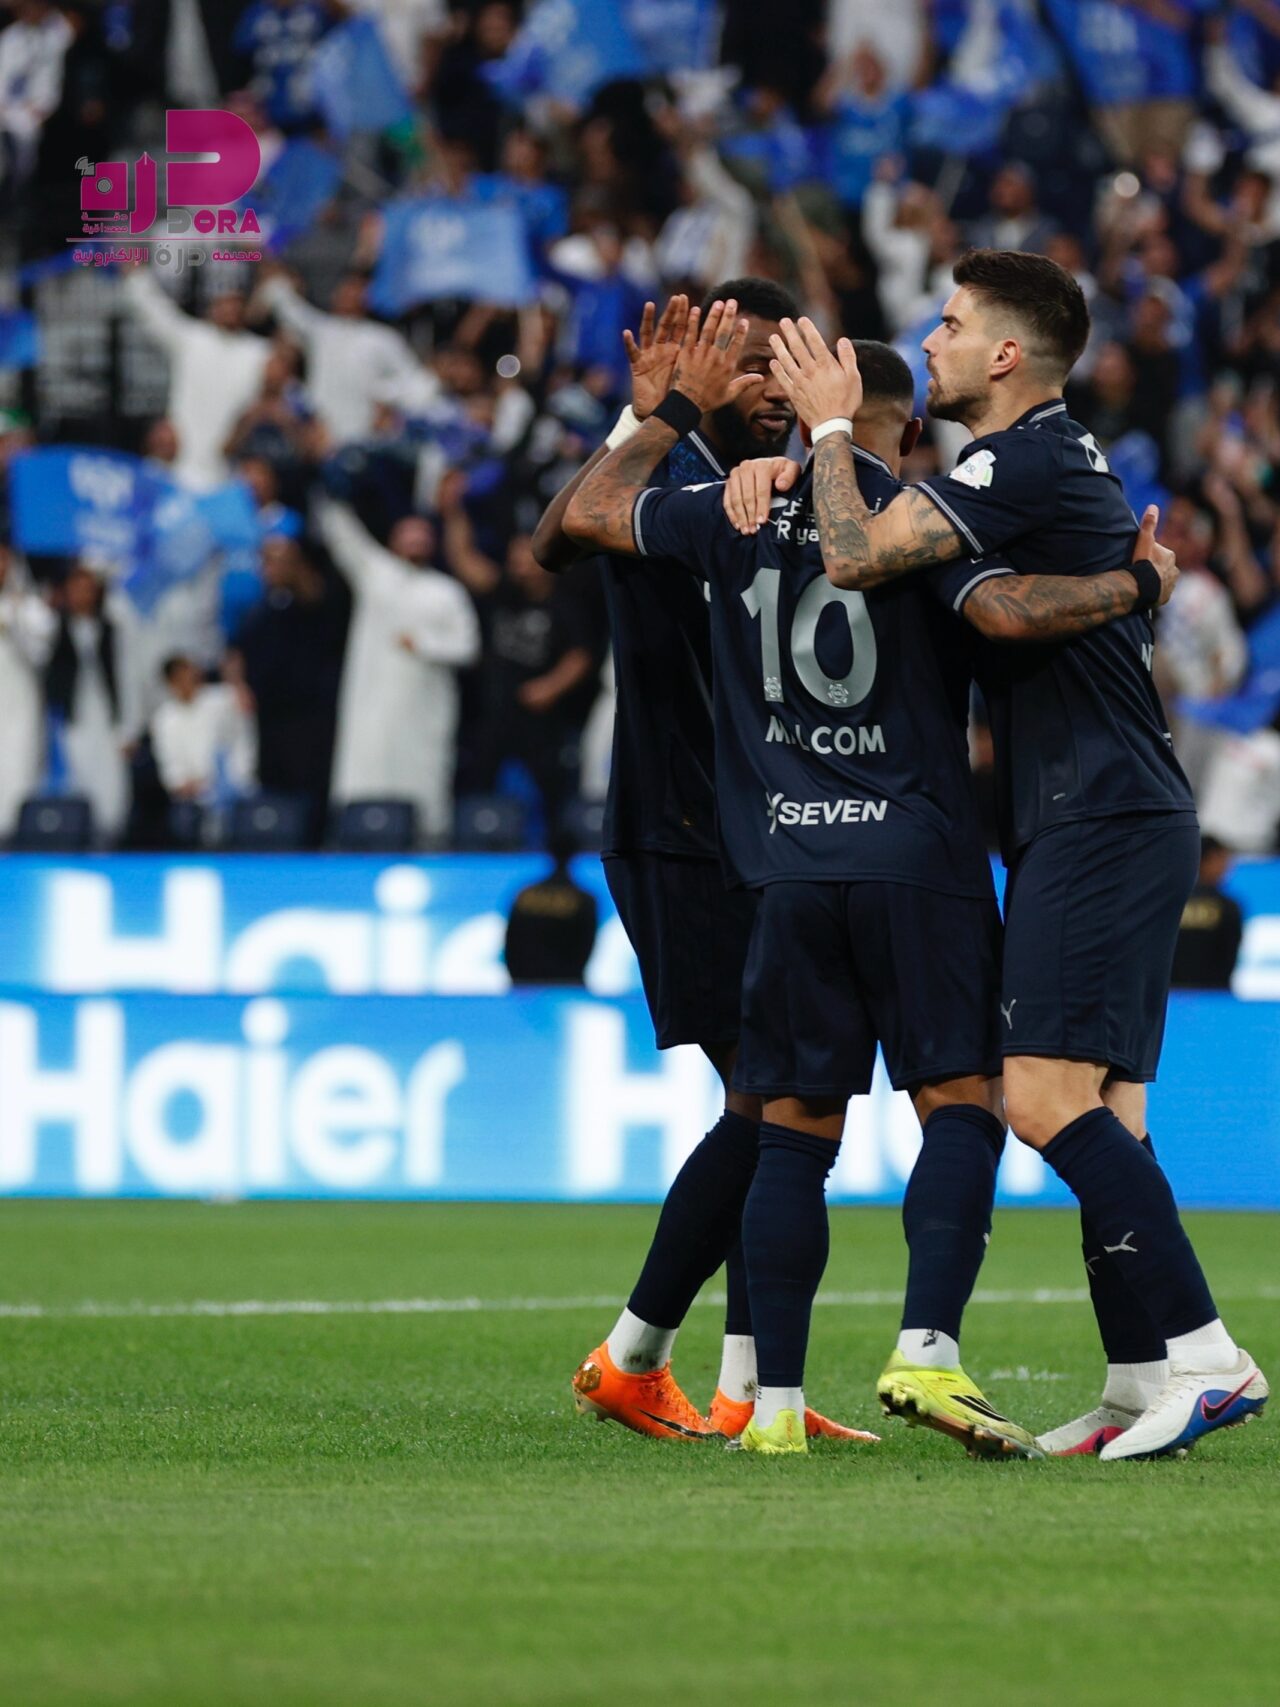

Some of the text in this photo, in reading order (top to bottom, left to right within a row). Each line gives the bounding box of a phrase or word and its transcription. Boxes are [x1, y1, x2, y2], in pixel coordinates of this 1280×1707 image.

[740, 567, 877, 708] 10
[778, 799, 888, 825] SEVEN
[0, 998, 466, 1194] Haier
